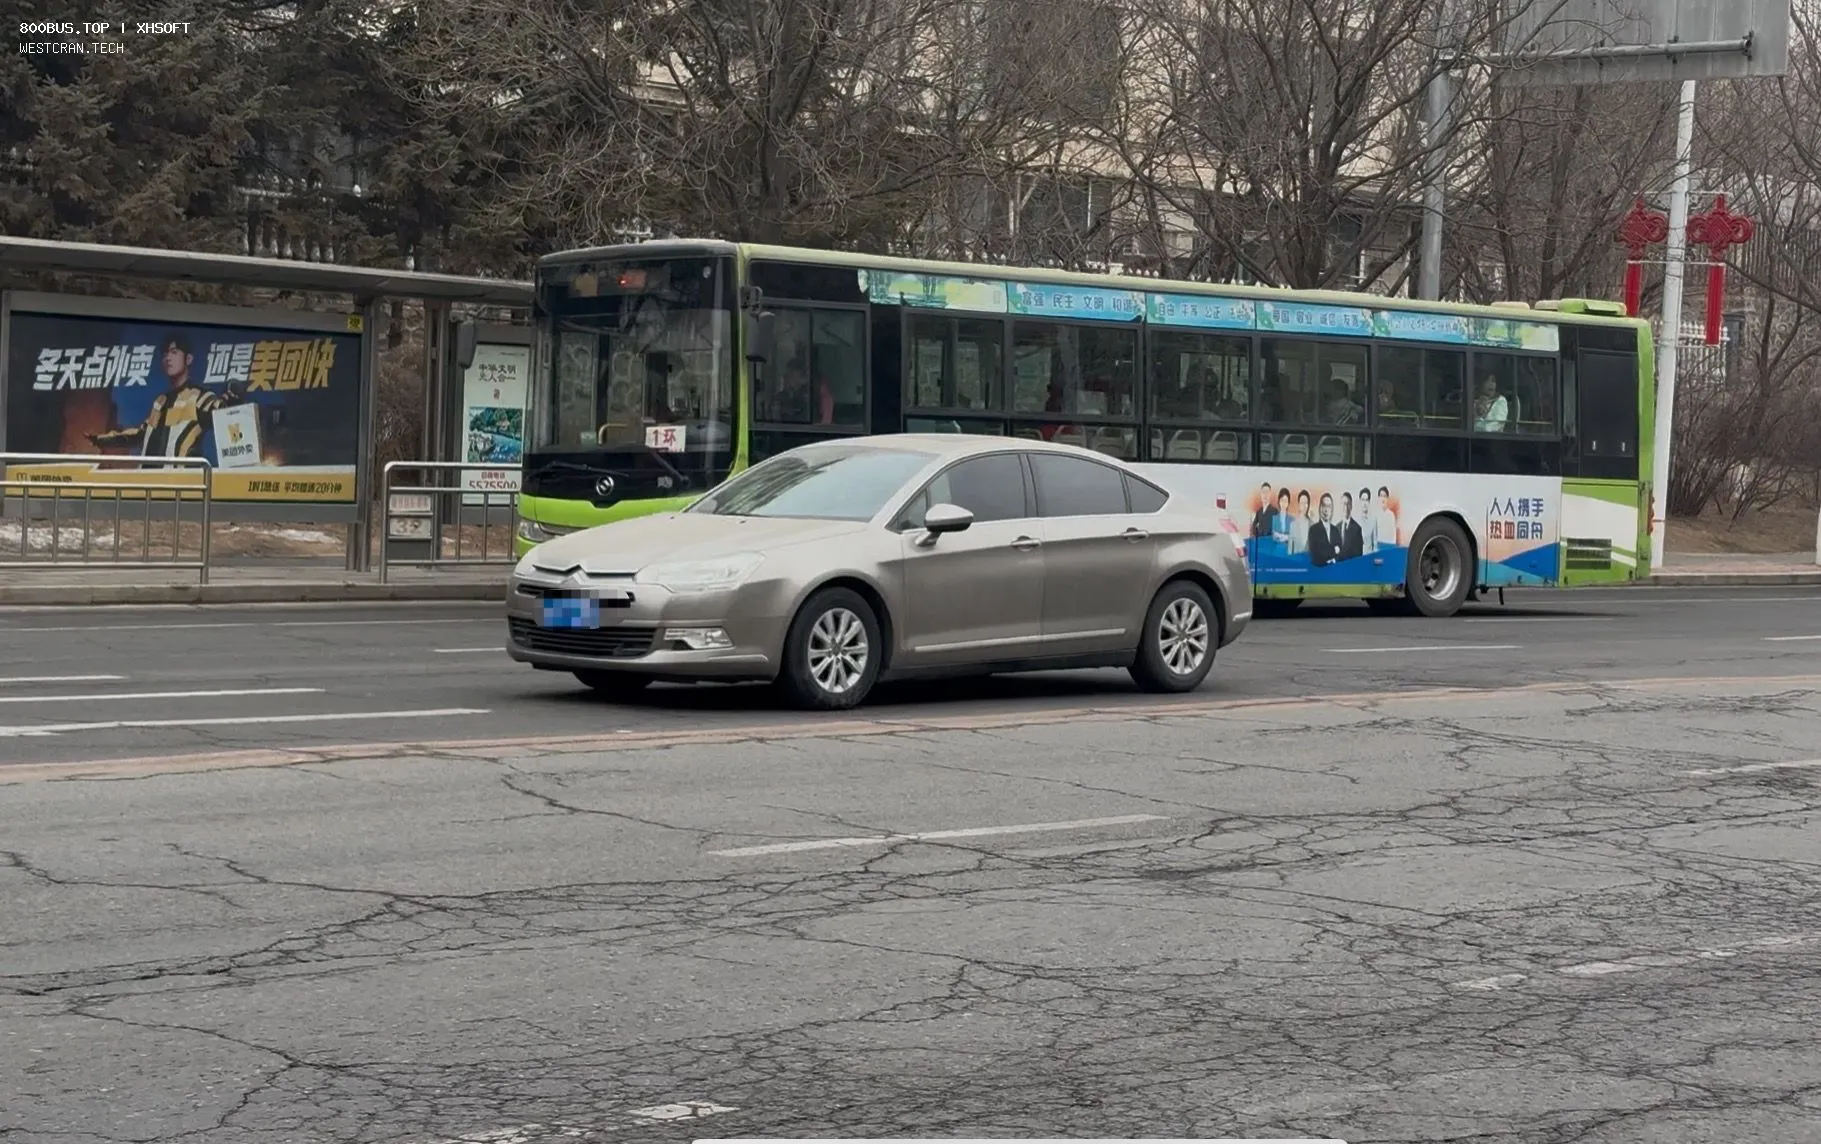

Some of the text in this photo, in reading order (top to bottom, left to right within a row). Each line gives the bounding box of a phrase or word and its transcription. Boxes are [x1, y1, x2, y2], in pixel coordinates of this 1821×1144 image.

[1053, 293, 1074, 309] 民主
[1083, 295, 1104, 311] 文明
[33, 337, 337, 392] 冬天点外卖 还是美团快
[652, 429, 677, 447] 1环
[1490, 497, 1544, 517] 人人携手
[1489, 520, 1543, 540] 热血同舟
